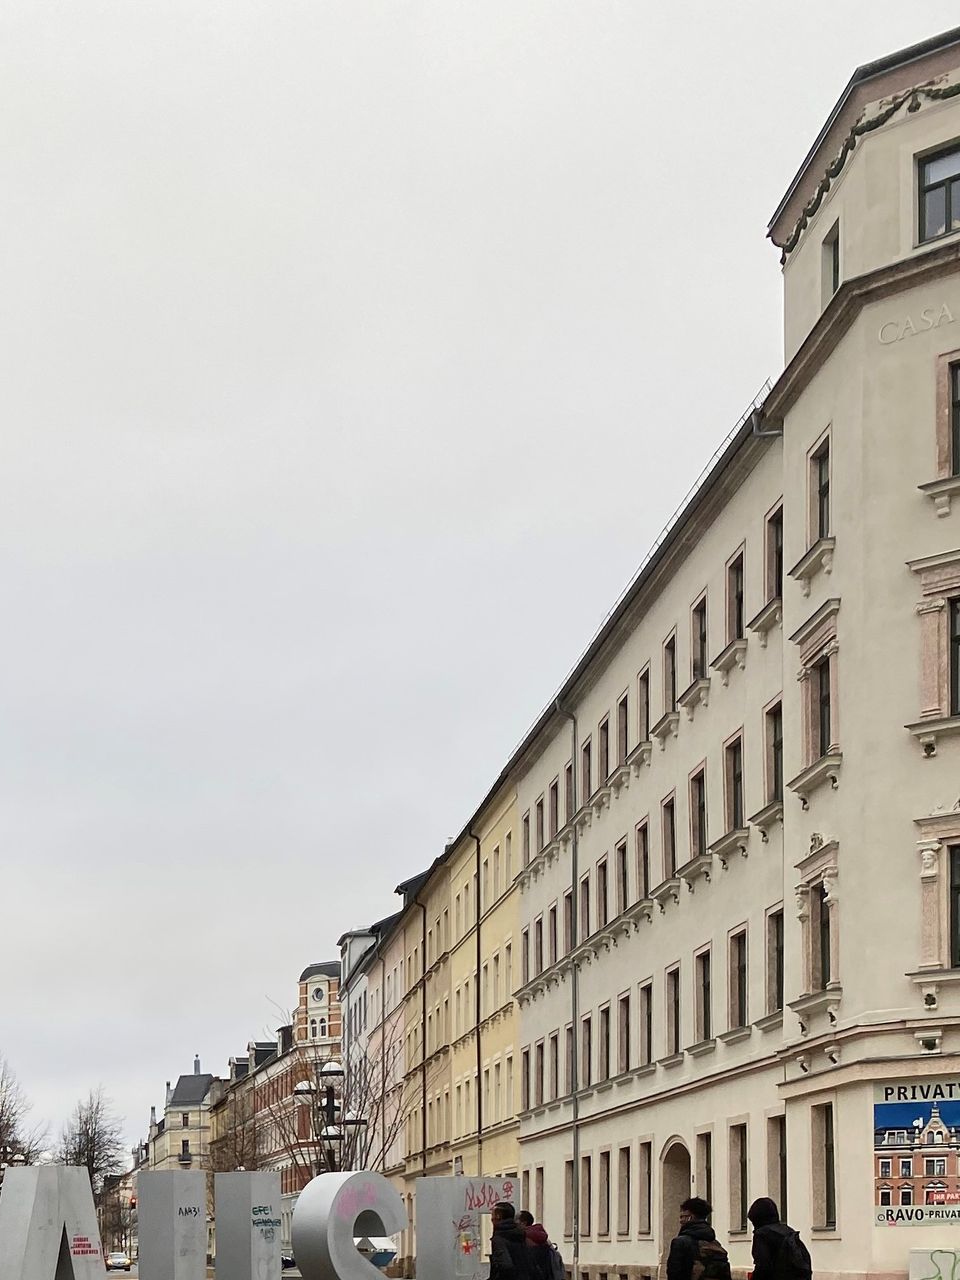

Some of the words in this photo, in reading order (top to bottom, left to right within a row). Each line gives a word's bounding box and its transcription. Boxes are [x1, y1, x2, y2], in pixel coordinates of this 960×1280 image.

[879, 303, 955, 345] CASA
[884, 1083, 960, 1101] PRIVAT
[946, 1192, 960, 1201] PAR
